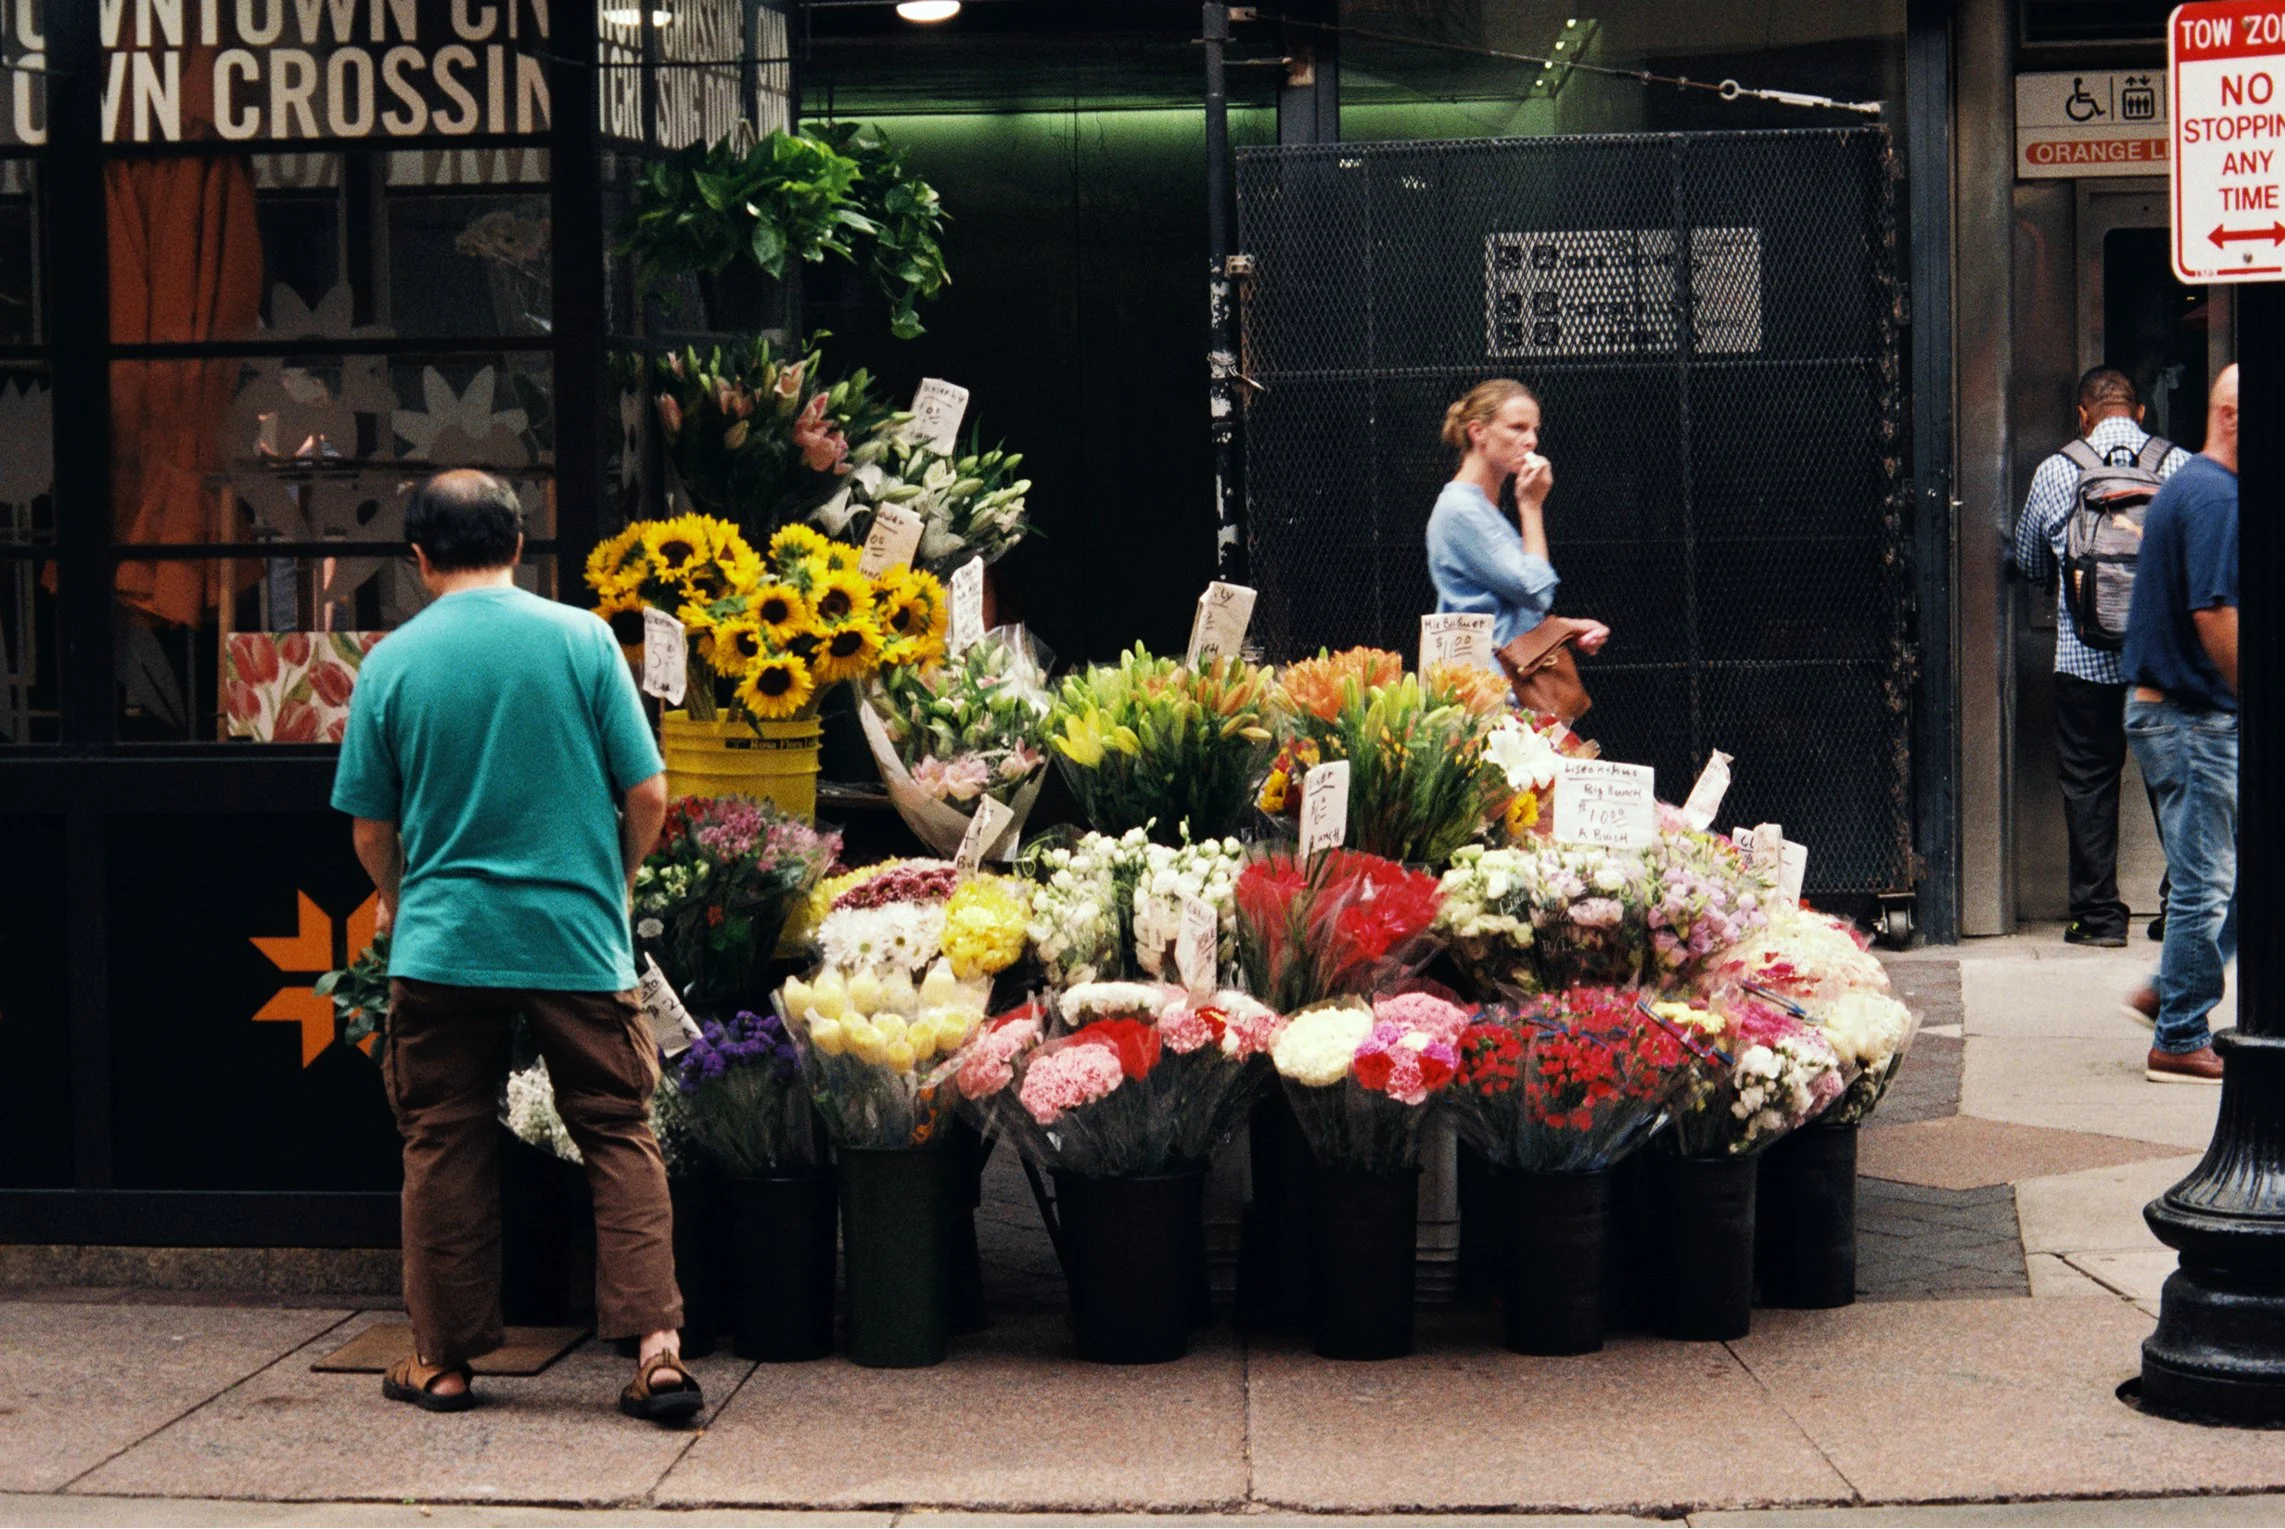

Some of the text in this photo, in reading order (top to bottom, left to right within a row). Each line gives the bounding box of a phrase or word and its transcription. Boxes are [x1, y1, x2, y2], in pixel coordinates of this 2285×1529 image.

[2180, 13, 2285, 50] TOW ZO
[213, 44, 551, 140] CROSSIN
[2221, 72, 2273, 106] NO
[2035, 140, 2171, 163] ORANGE LI
[2222, 149, 2274, 176] ANY
[2218, 185, 2279, 211] TIME
